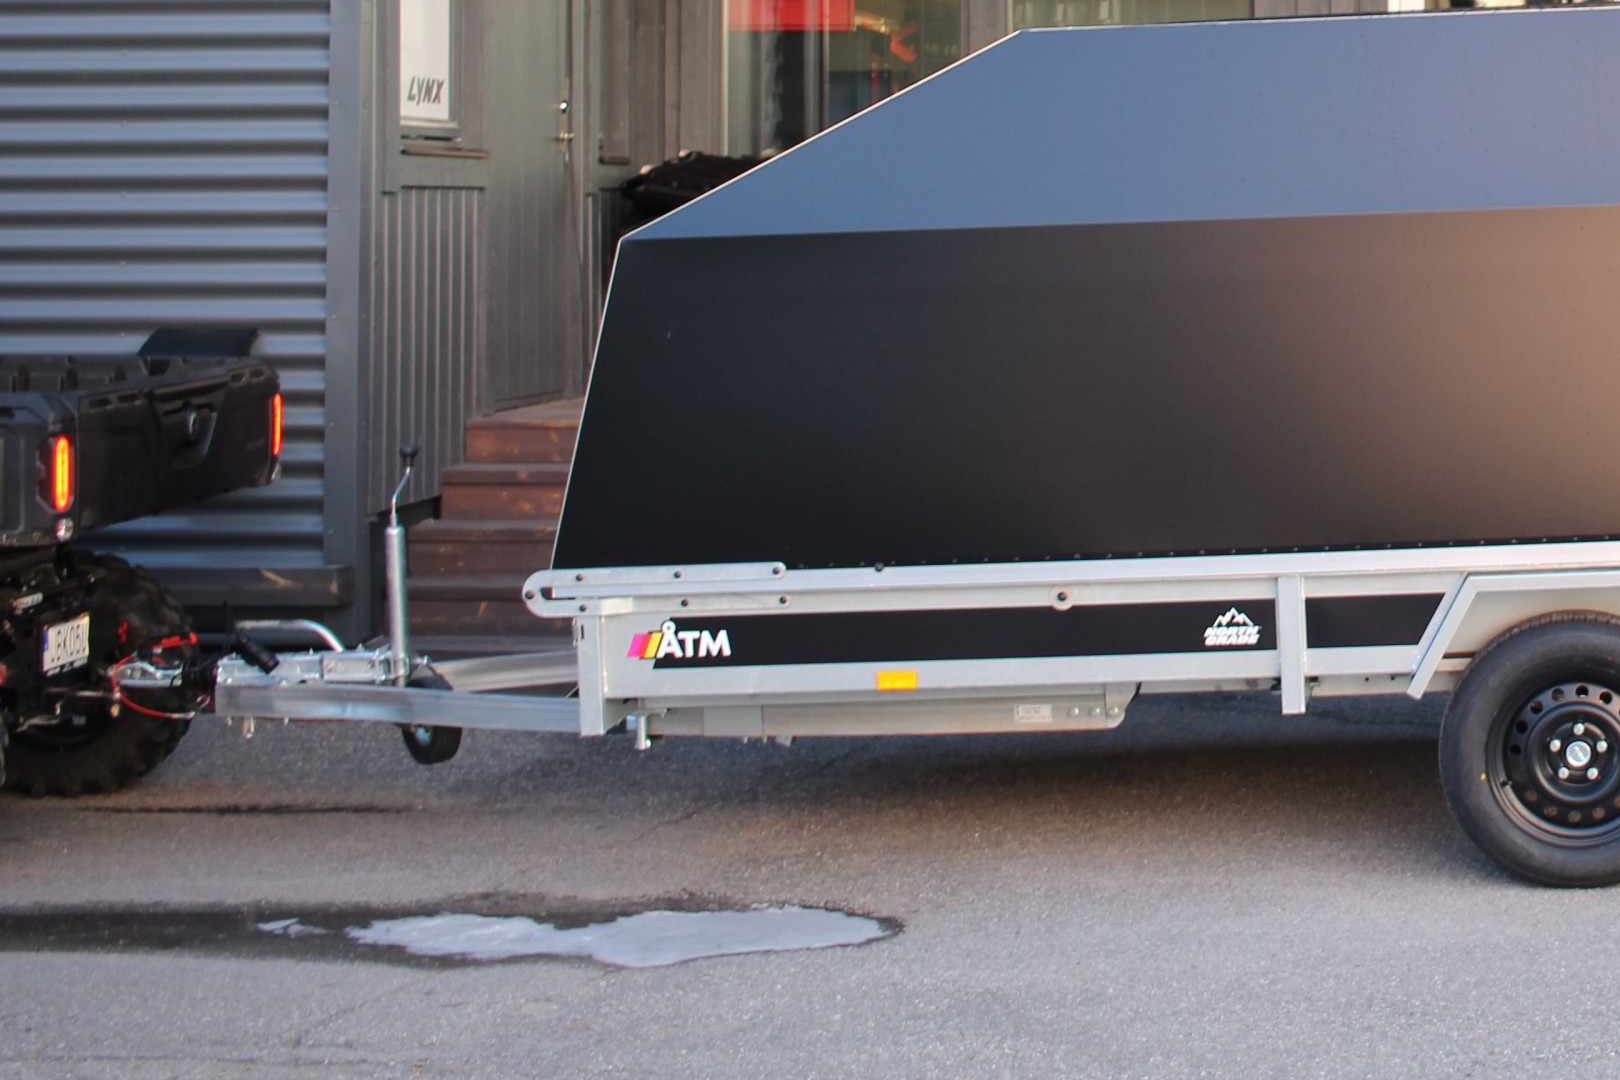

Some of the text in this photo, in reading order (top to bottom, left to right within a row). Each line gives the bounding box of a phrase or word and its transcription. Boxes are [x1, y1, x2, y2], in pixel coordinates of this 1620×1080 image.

[406, 75, 446, 106] LYNX
[655, 619, 732, 659] ÅTM
[1203, 625, 1260, 638] NORTH
[1204, 634, 1260, 646] GRADE
